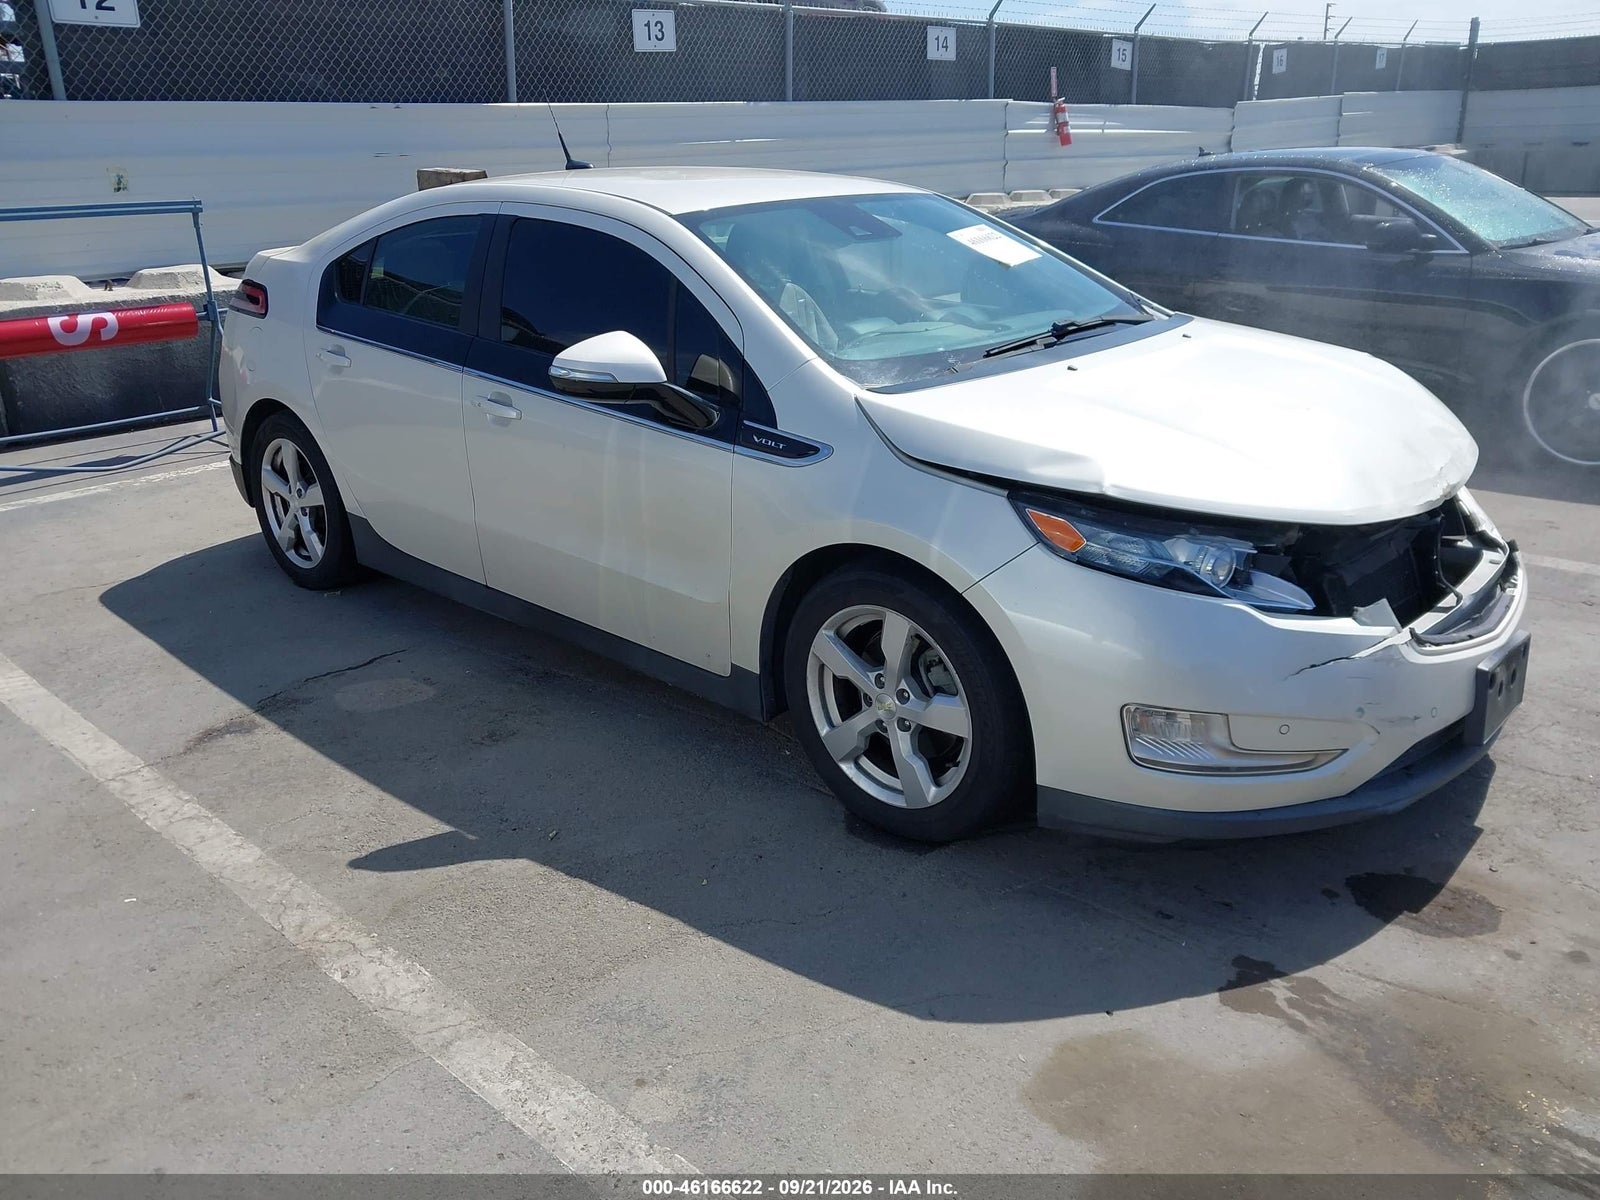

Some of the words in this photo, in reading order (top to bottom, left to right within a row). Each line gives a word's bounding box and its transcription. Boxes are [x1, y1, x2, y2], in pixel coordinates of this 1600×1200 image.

[644, 20, 665, 41] 13
[934, 35, 949, 52] 14
[1117, 48, 1127, 62] 15
[752, 434, 787, 449] VOLT
